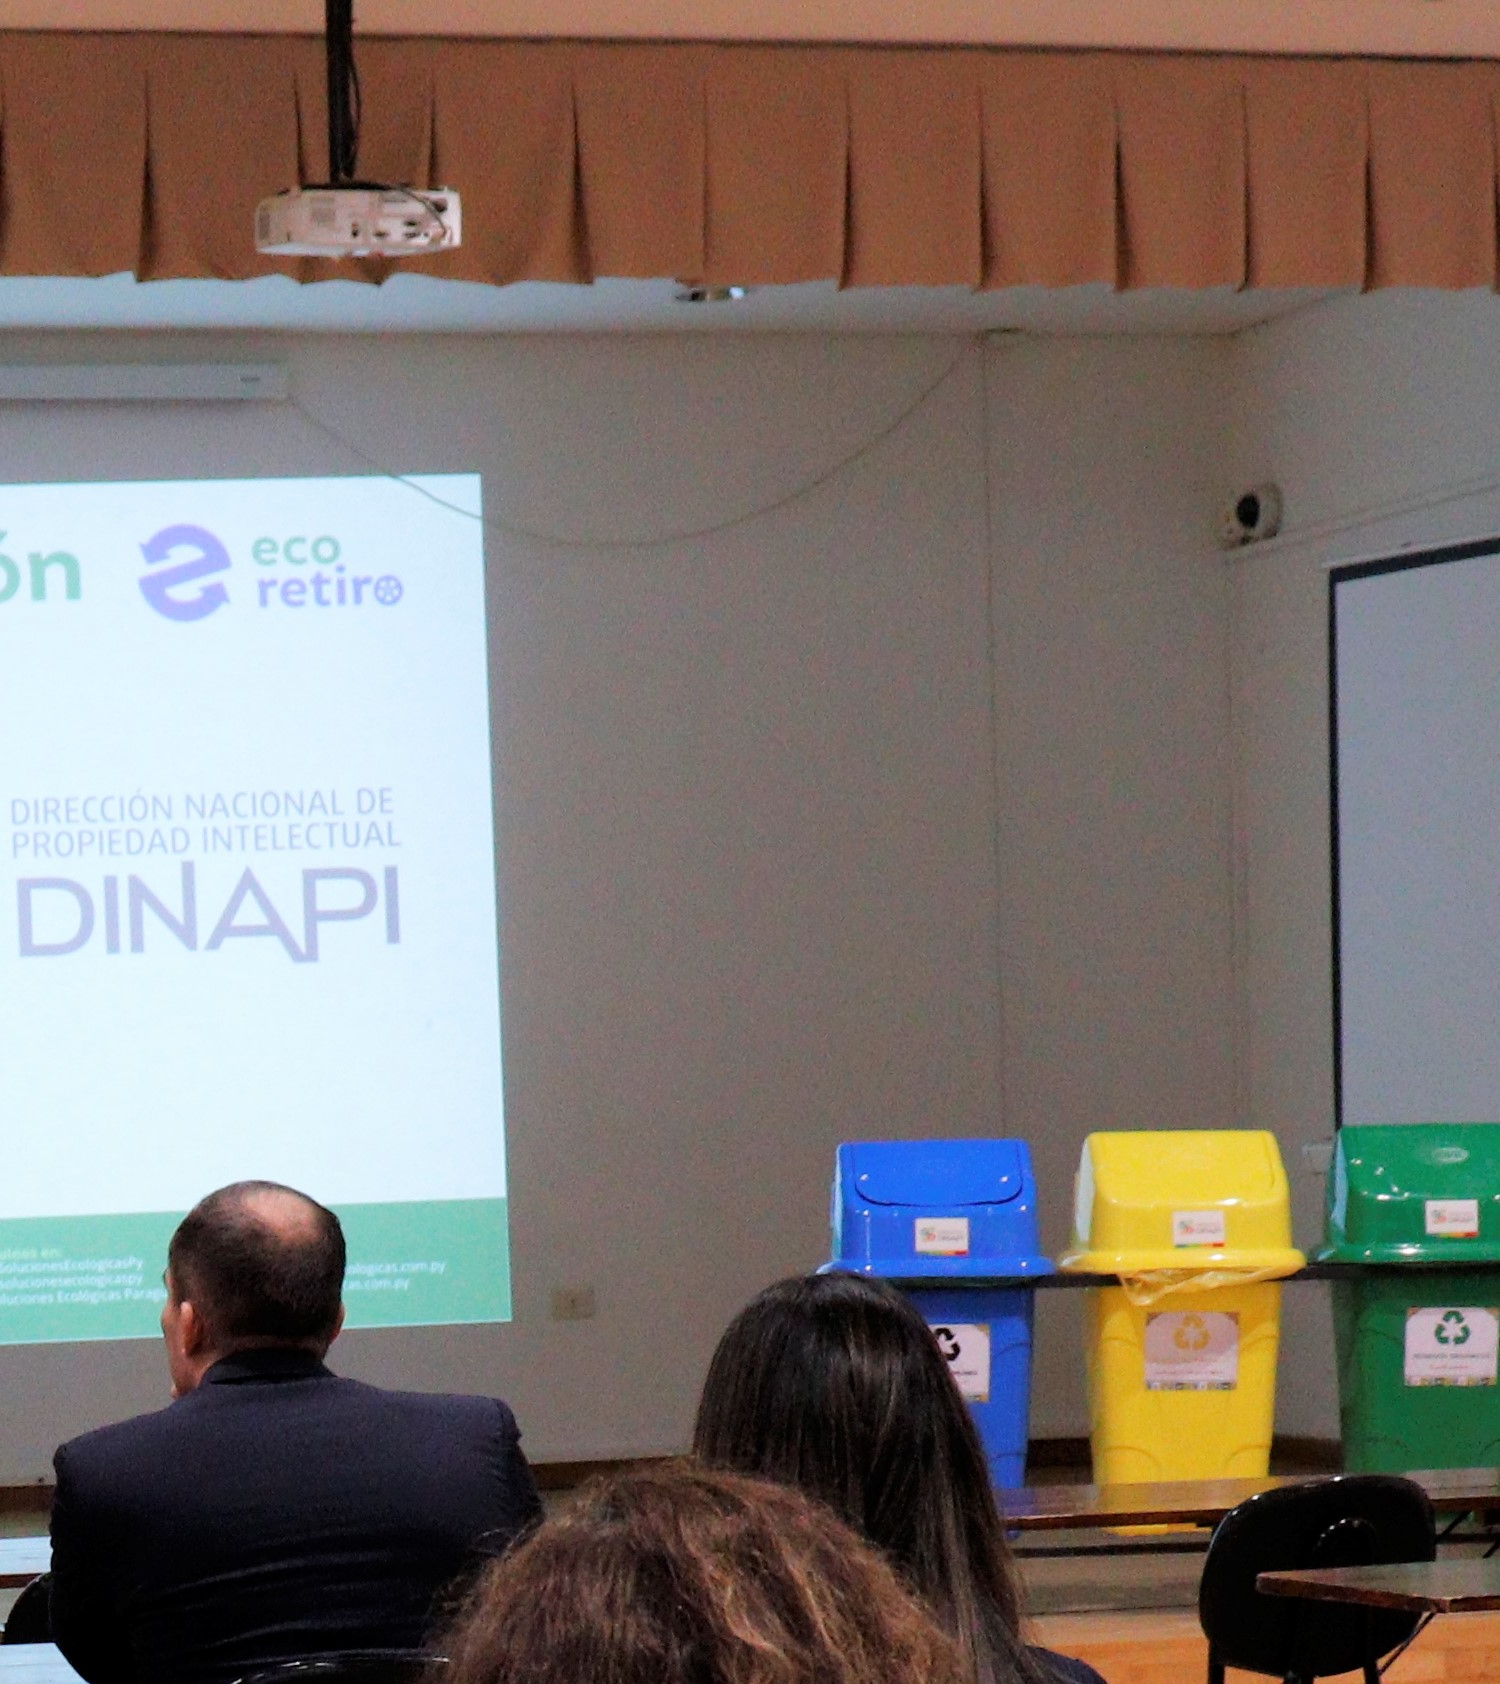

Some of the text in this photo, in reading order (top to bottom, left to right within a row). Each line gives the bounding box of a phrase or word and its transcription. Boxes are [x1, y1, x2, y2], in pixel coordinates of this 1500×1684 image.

[251, 535, 341, 566] eco
[257, 564, 404, 608] retiro
[10, 787, 394, 826] DIRECCIÓN NACIONAL DE
[11, 820, 402, 859] PROPIEDAD INTELECTUAL
[16, 860, 402, 964] DINAPI
